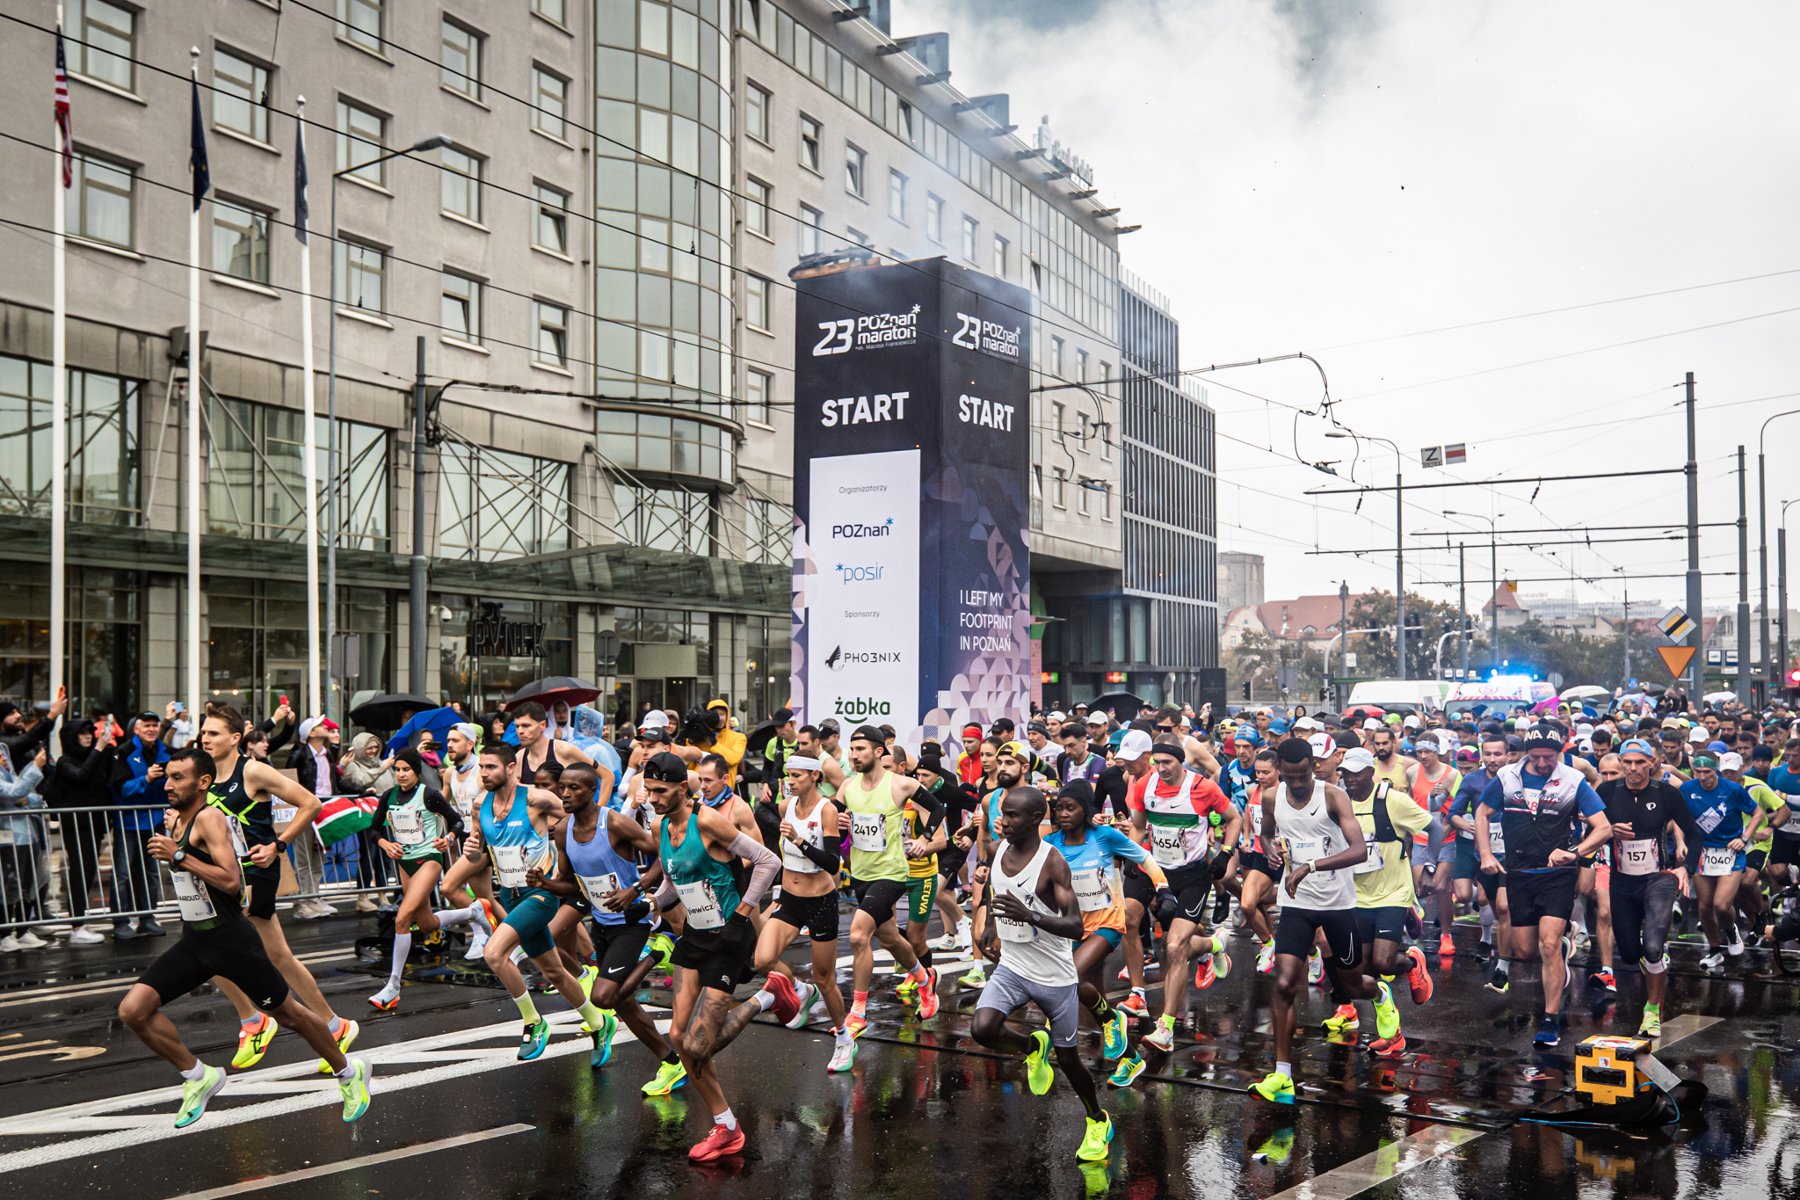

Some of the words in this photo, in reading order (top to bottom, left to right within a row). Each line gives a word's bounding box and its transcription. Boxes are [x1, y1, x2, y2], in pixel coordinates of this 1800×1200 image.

[813, 318, 855, 356] 23
[858, 326, 917, 345] maraton
[952, 312, 981, 350] 23
[983, 336, 1019, 358] maraton
[821, 391, 910, 427] START
[959, 394, 1015, 432] START
[838, 484, 888, 495] Organizatorzy
[843, 562, 885, 585] posir
[960, 589, 963, 604] I
[966, 590, 988, 606] LEFT
[989, 592, 1004, 607] MY
[844, 610, 881, 619] Sponsorzy
[960, 612, 1013, 630] FOOTPRINT
[473, 620, 547, 656] RYNEK
[960, 636, 970, 651] IN
[973, 634, 1012, 652] POZNAŃ
[834, 696, 891, 716] żabka
[854, 823, 878, 837] 2419
[1153, 836, 1180, 849] 4654
[1627, 851, 1647, 862] 157
[1705, 853, 1731, 865] 1040
